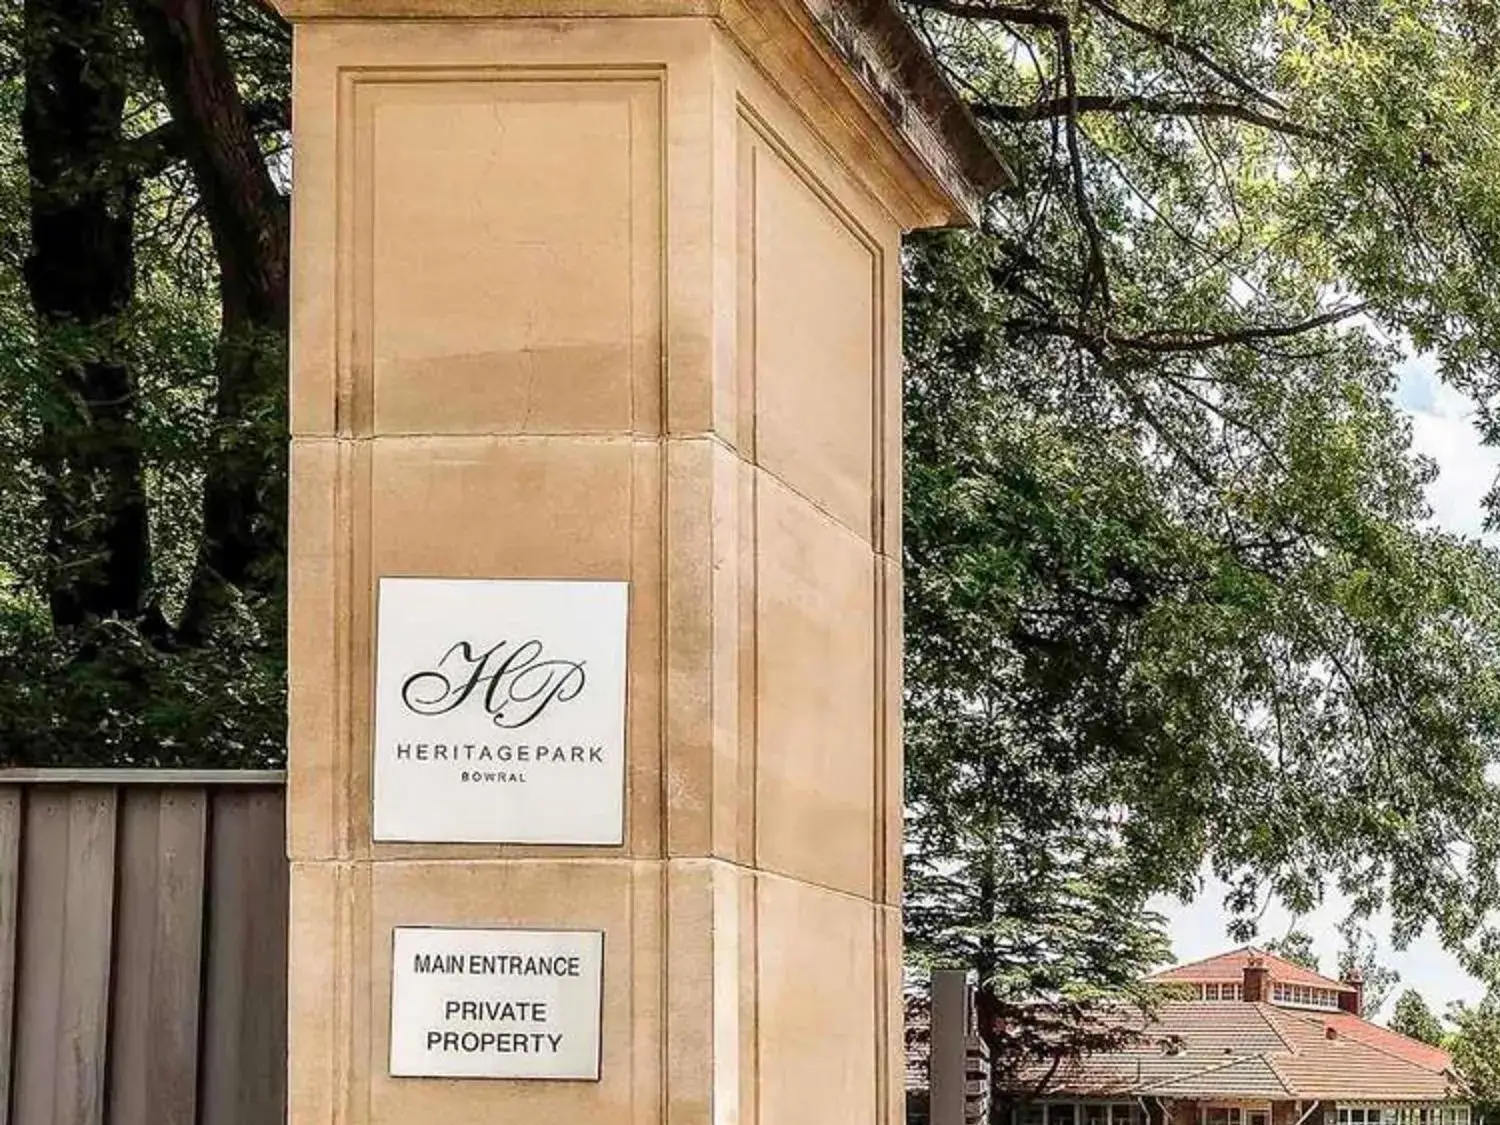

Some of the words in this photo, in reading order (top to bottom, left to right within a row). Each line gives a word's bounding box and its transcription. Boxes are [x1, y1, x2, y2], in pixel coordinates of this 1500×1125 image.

[401, 639, 587, 729] HP
[461, 771, 527, 783] BOWRAL
[413, 954, 465, 974] MAIN
[469, 955, 581, 977] ENTRANCE
[445, 1001, 548, 1022] PRIVATE
[427, 1031, 563, 1053] PROPERTY
